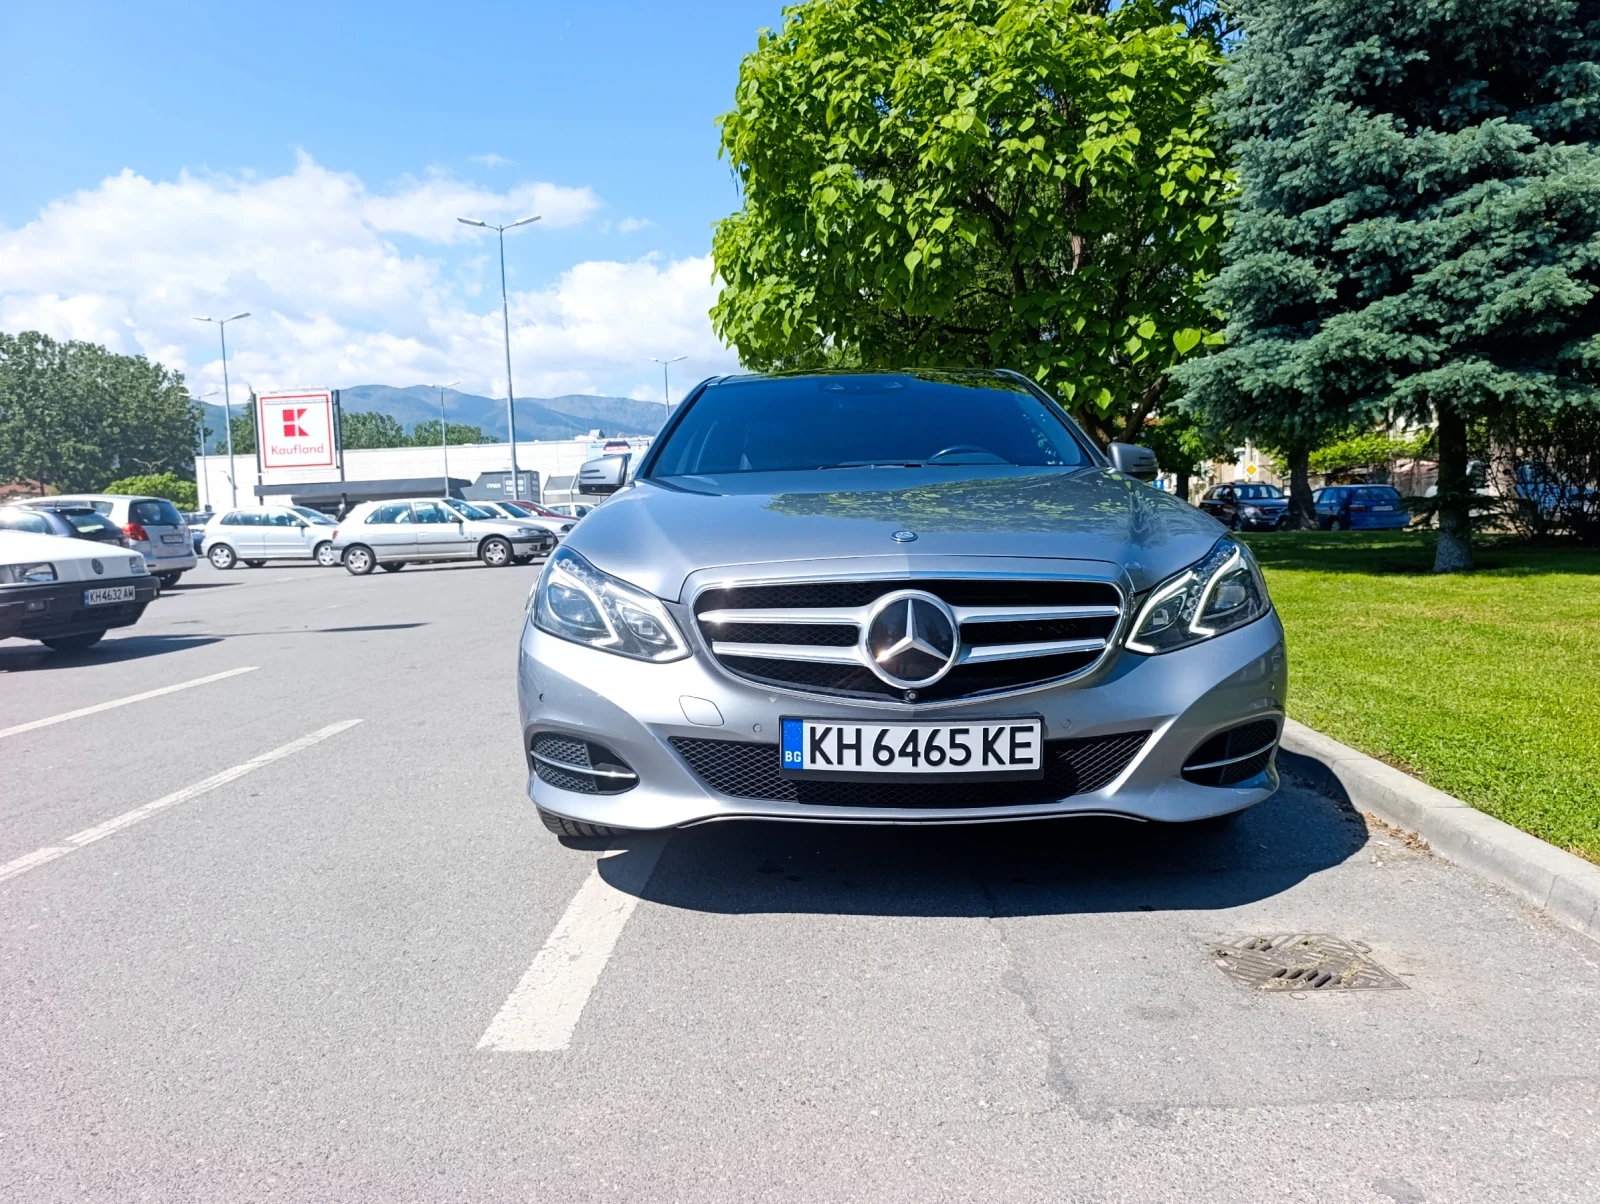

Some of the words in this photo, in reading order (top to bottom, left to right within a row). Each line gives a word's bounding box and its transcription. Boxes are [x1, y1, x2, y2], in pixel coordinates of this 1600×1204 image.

[271, 444, 324, 455] Kaufland
[90, 590, 101, 603] KH
[102, 589, 122, 601] 4632
[809, 726, 862, 766] KH
[872, 728, 972, 767] 6465
[982, 725, 1034, 766] KE
[785, 750, 802, 762] BG
